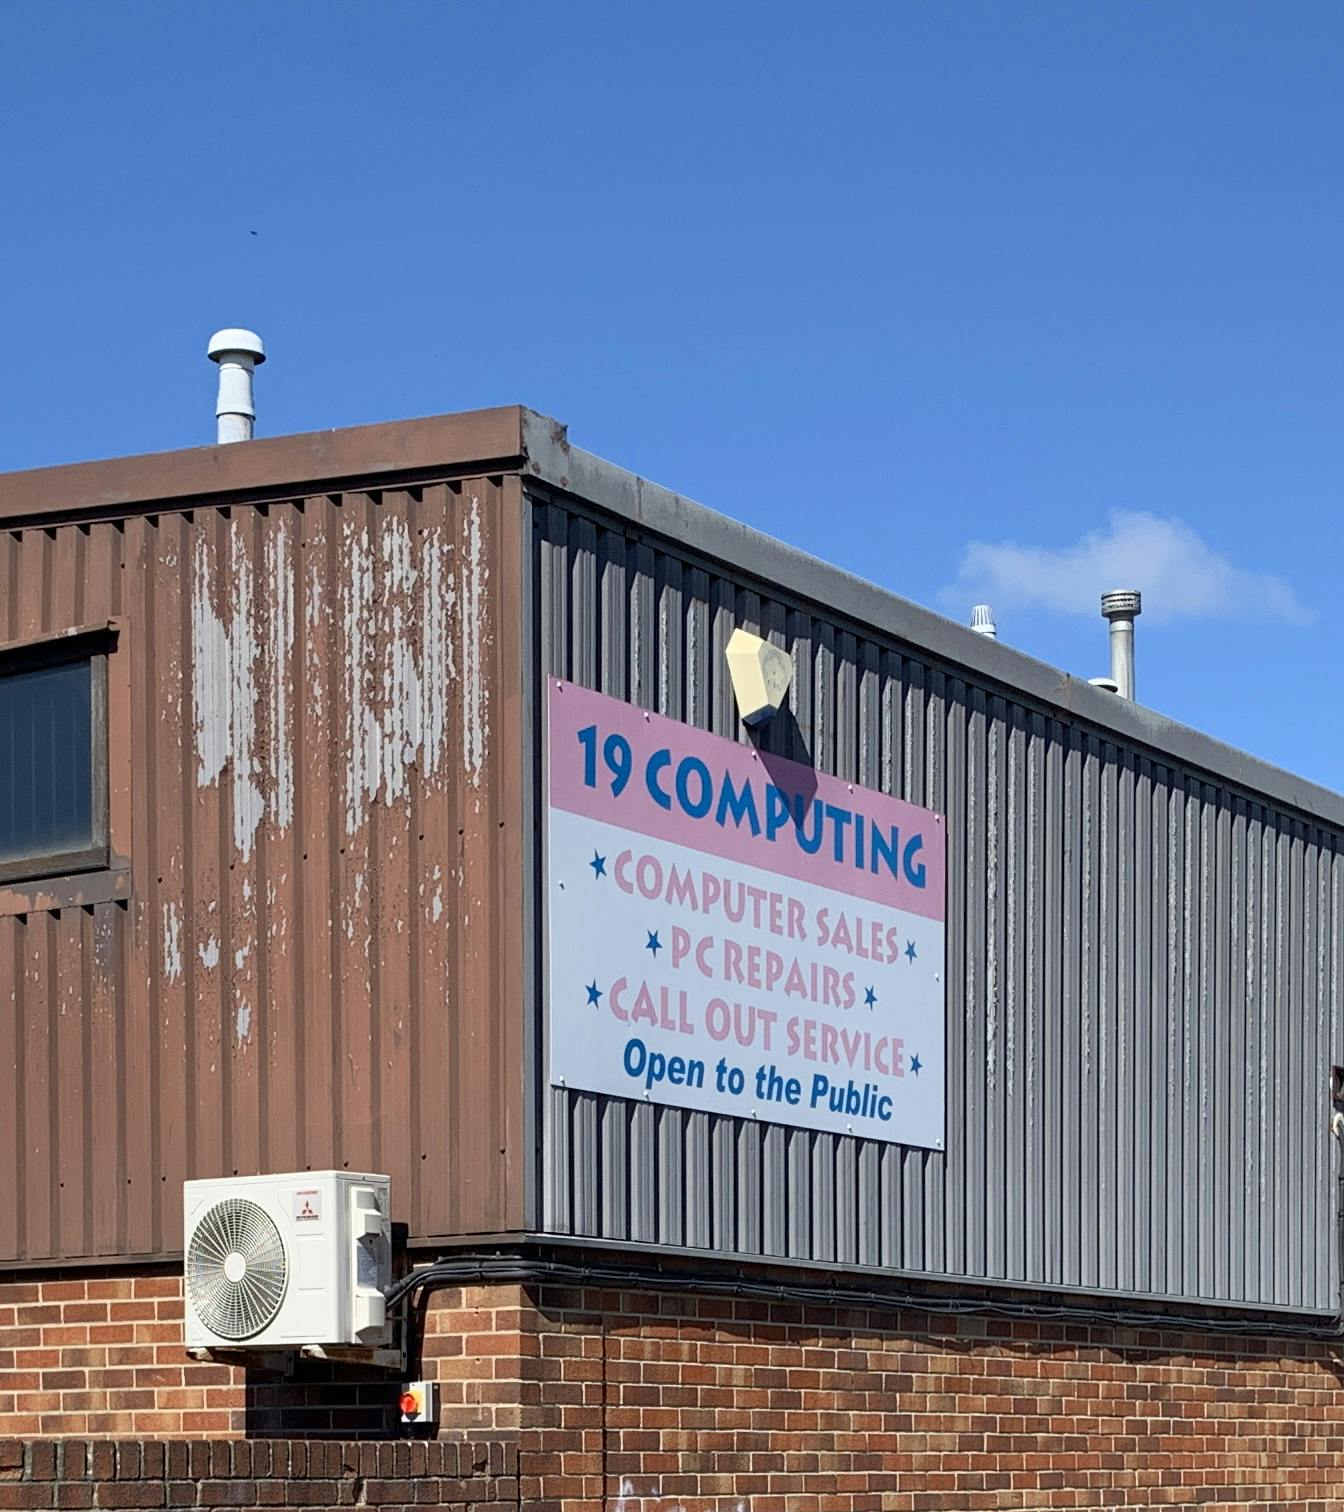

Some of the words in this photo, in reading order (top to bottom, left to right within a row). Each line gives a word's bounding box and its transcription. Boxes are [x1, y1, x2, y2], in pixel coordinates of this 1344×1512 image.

[577, 725, 633, 797] 19
[644, 748, 927, 889] COMPUTING
[614, 849, 807, 941] COMPUTER
[816, 907, 899, 965] SALES
[671, 925, 714, 978] PC
[724, 939, 857, 1010] REPAIRS
[609, 976, 694, 1036] CALL
[705, 997, 777, 1051] OUT
[787, 1016, 905, 1078] SERVICE
[623, 1037, 705, 1090] Open
[714, 1057, 746, 1097] to
[755, 1065, 803, 1105] the
[810, 1073, 894, 1121] Public
